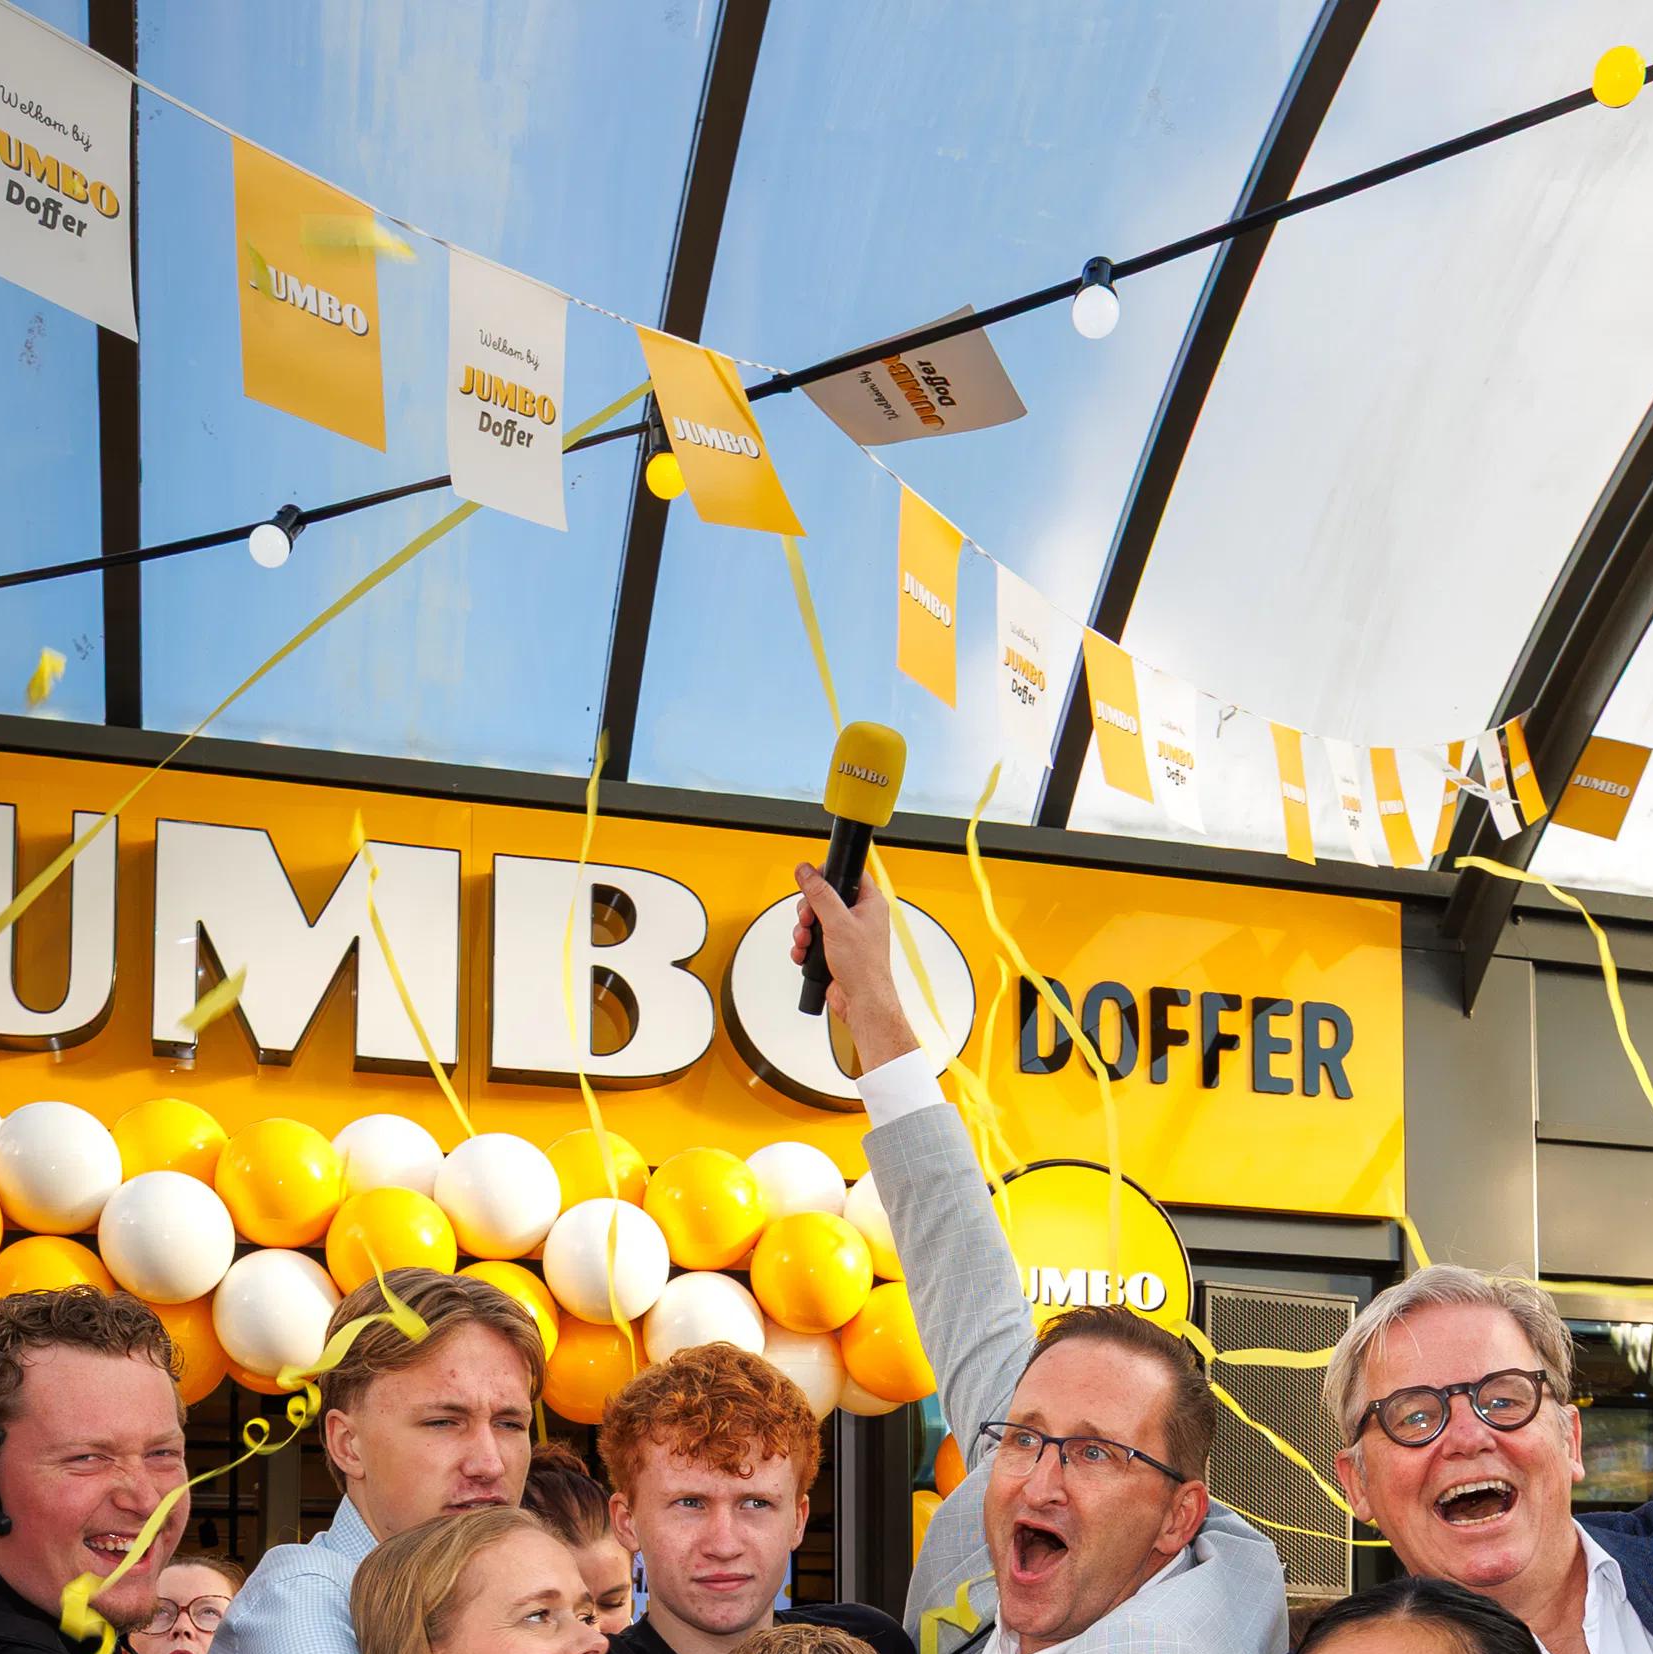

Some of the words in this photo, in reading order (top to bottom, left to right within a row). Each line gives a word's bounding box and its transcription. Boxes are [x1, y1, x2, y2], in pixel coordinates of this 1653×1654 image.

[0, 84, 68, 137] Welkom
[72, 123, 93, 153] bij
[5, 178, 87, 239] Doffer
[248, 264, 369, 336] UMBO
[479, 329, 524, 362] Welkom
[527, 351, 540, 371] bij
[459, 365, 556, 425] JUMBO
[869, 382, 899, 420] Welkom
[917, 360, 956, 406] Doffer
[478, 411, 533, 448] Doffer
[673, 416, 760, 459] JUMBO
[903, 571, 952, 628] JUMBO
[1004, 646, 1046, 692] JUMBO
[1011, 678, 1036, 706] Doffer
[1096, 700, 1138, 735] JUMBO
[837, 762, 889, 787] JUMBO
[1157, 740, 1195, 770] JUMBO
[1572, 774, 1631, 798] JUMBO
[1019, 974, 1355, 1100] DOFFER
